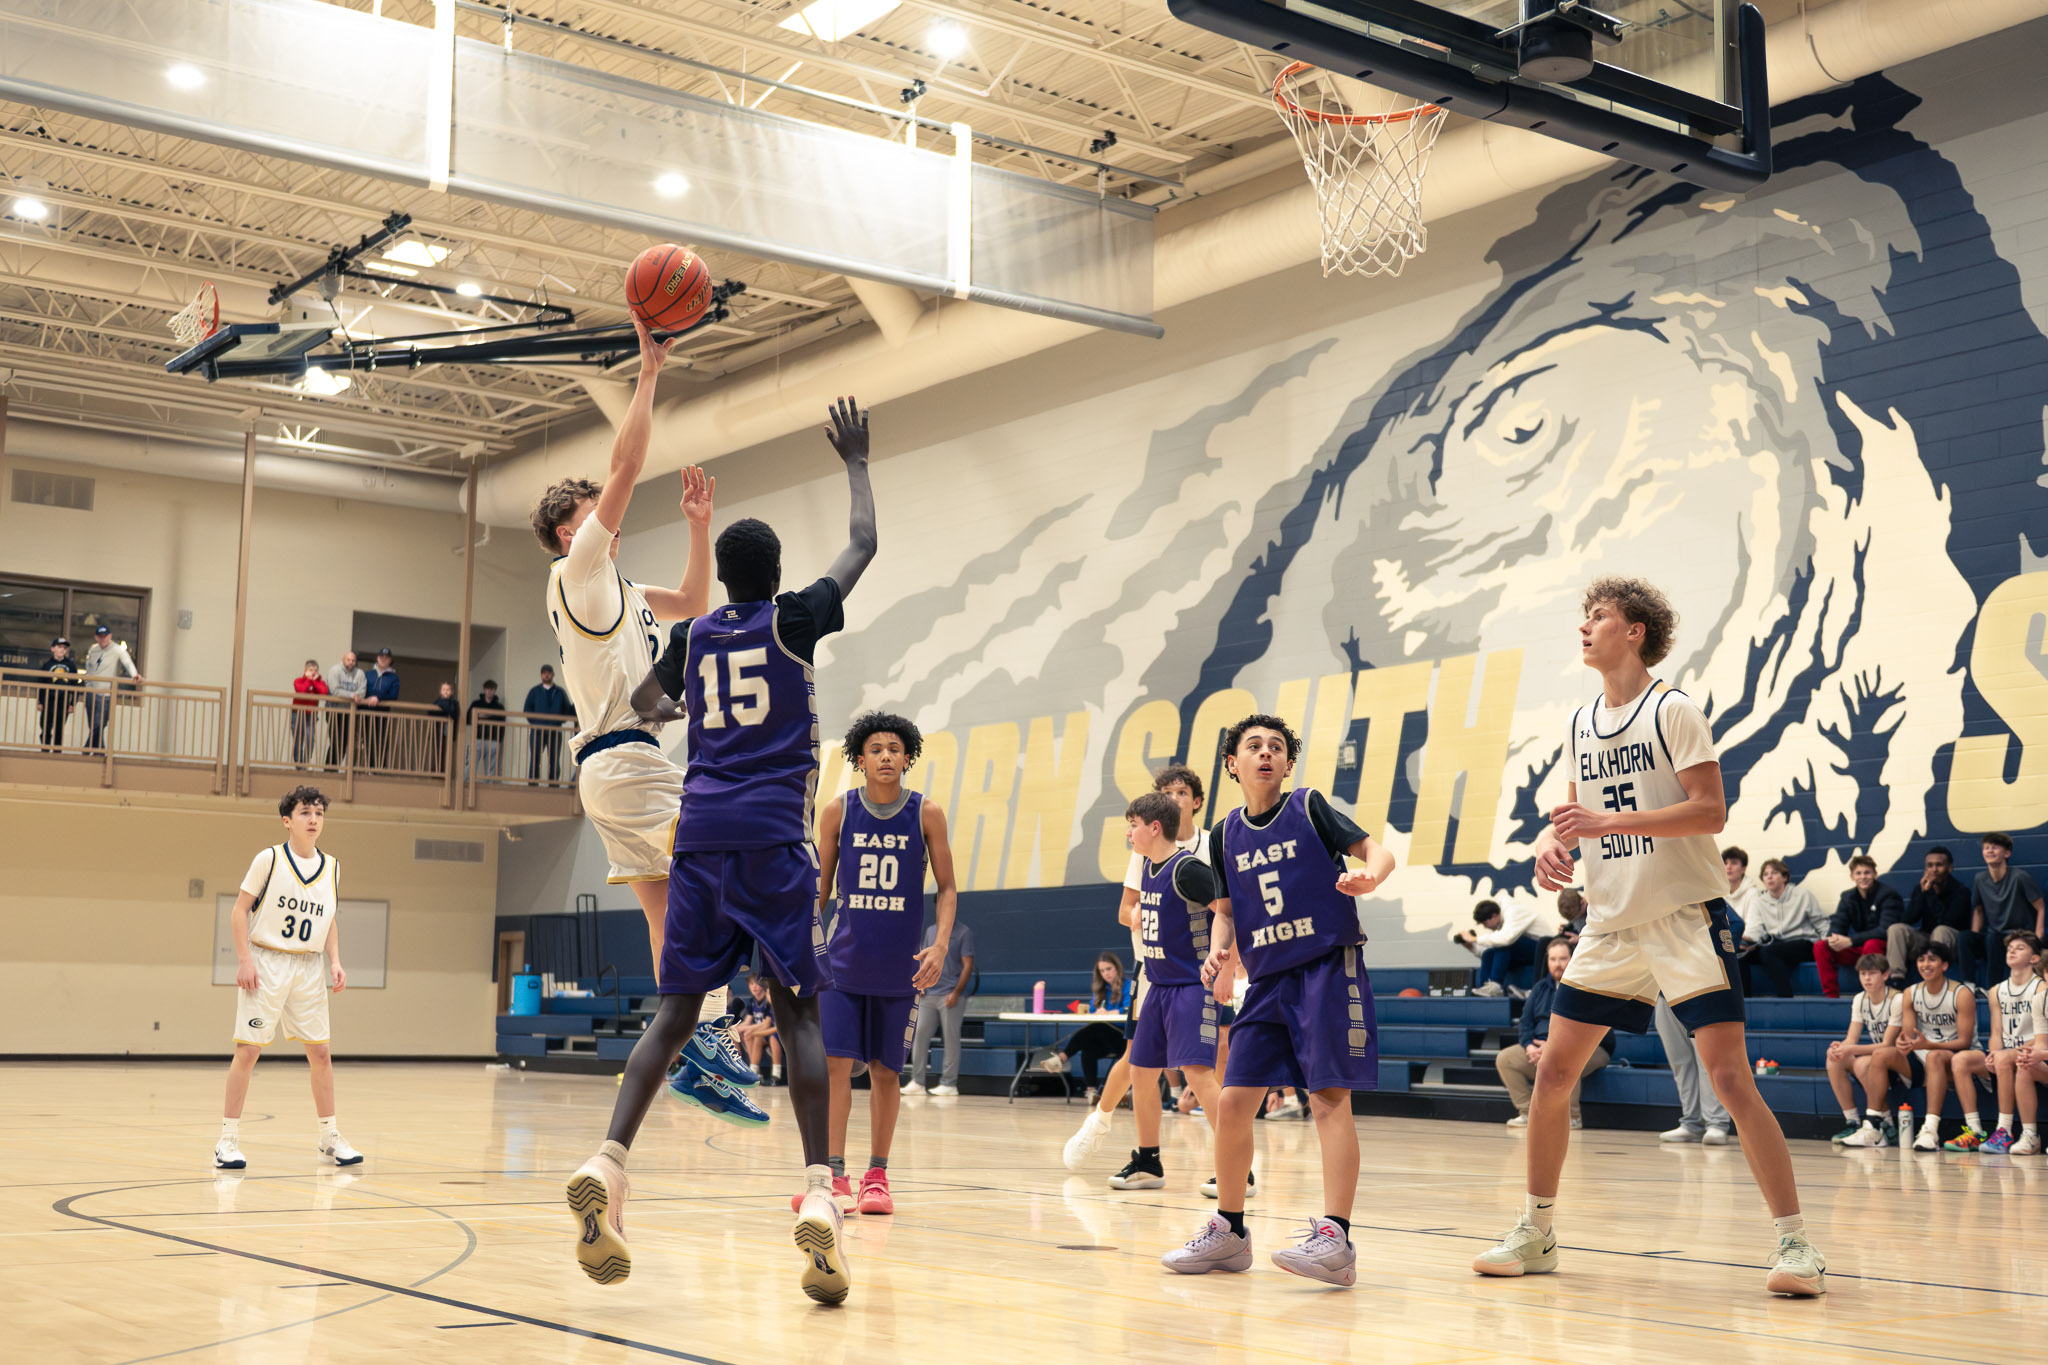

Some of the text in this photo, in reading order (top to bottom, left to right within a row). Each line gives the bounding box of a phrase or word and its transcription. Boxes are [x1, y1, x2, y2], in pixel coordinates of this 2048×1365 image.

[666, 274, 682, 294] PRO
[698, 647, 771, 729] 15
[1098, 648, 1525, 883] SOUTH
[1581, 741, 1656, 782] ELKHORN
[853, 833, 909, 851] EAST
[1235, 839, 1298, 873] EAST
[1600, 833, 1654, 860] SOUTH
[858, 853, 899, 890] 20
[277, 895, 324, 917] SOUTH
[849, 894, 905, 912] HIGH
[1141, 890, 1163, 906] EAST
[1257, 870, 1285, 917] 5
[281, 915, 312, 942] 30
[1141, 909, 1159, 941] 22
[1252, 916, 1315, 948] HIGH
